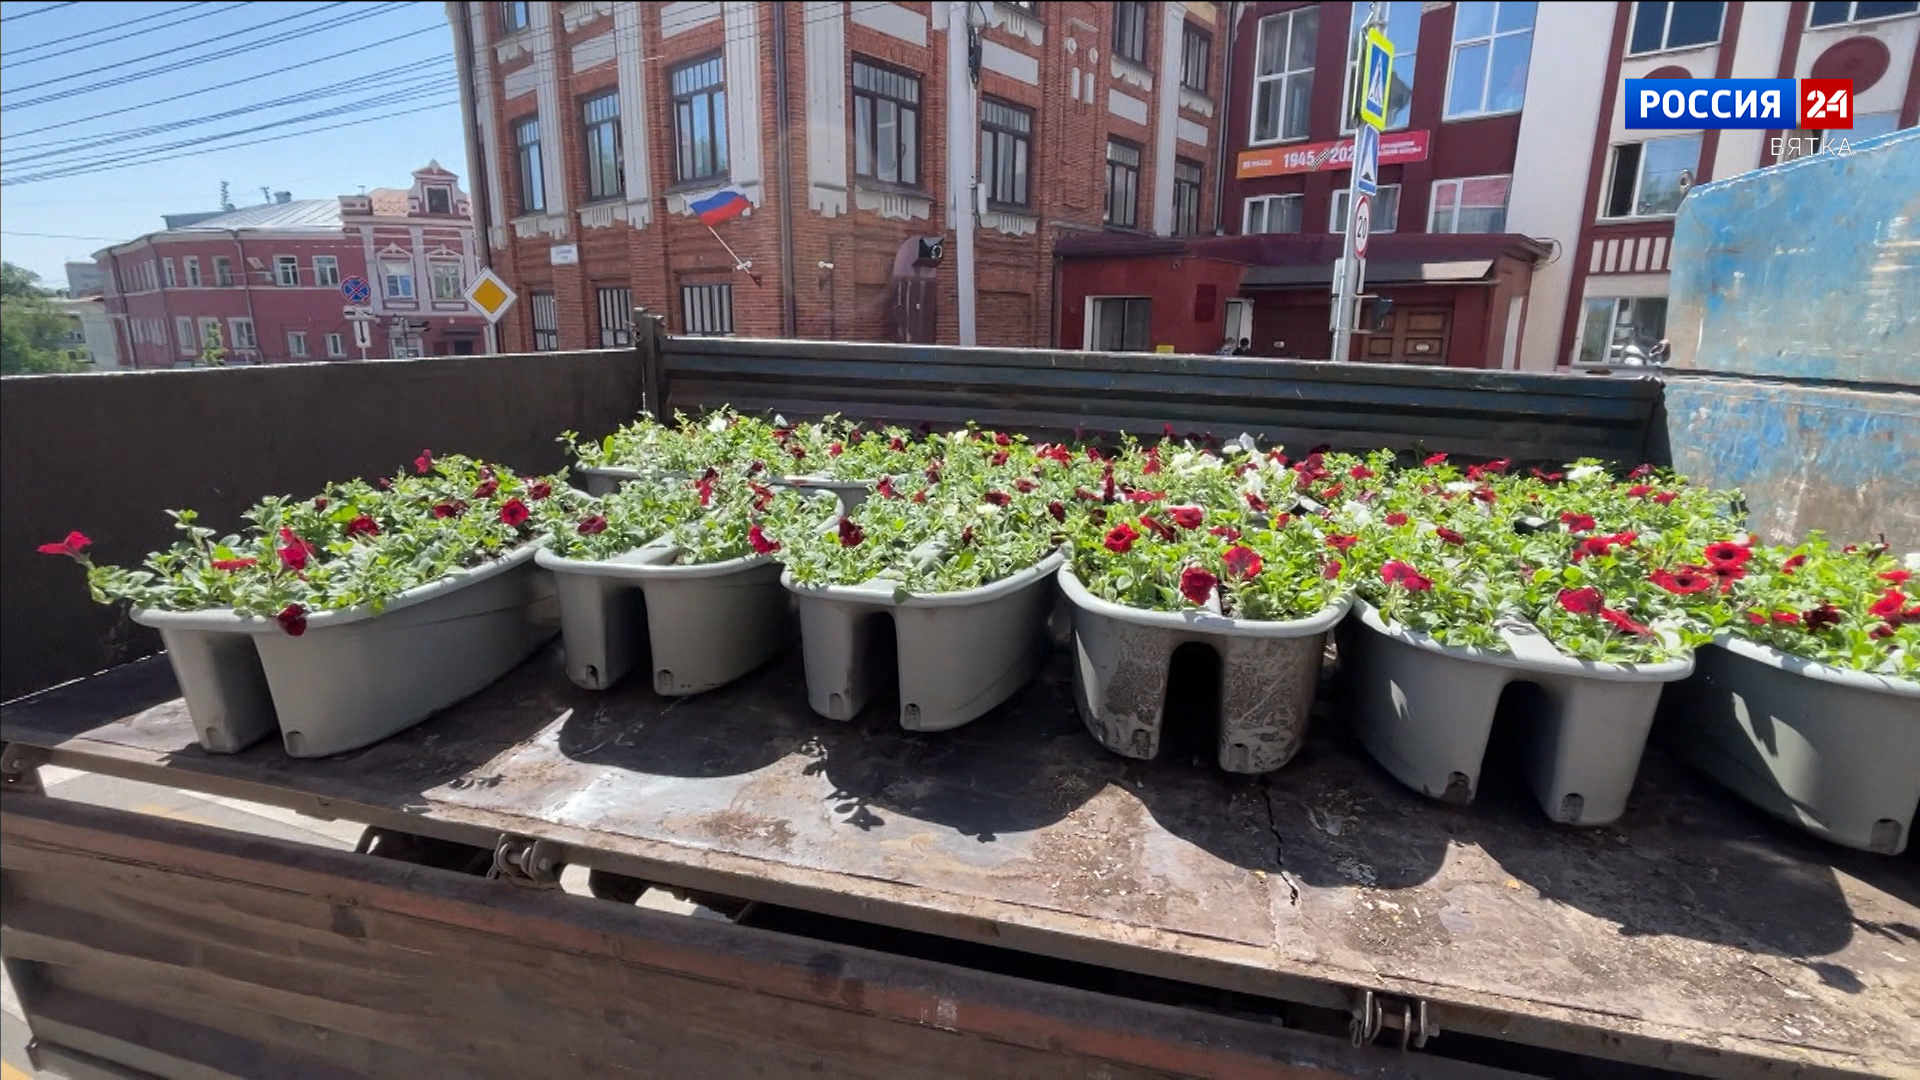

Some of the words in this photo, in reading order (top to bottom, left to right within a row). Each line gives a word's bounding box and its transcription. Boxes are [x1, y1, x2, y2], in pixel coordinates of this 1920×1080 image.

[1283, 150, 1317, 168] 1945
[1329, 145, 1355, 164] 202
[1357, 215, 1367, 239] 20
